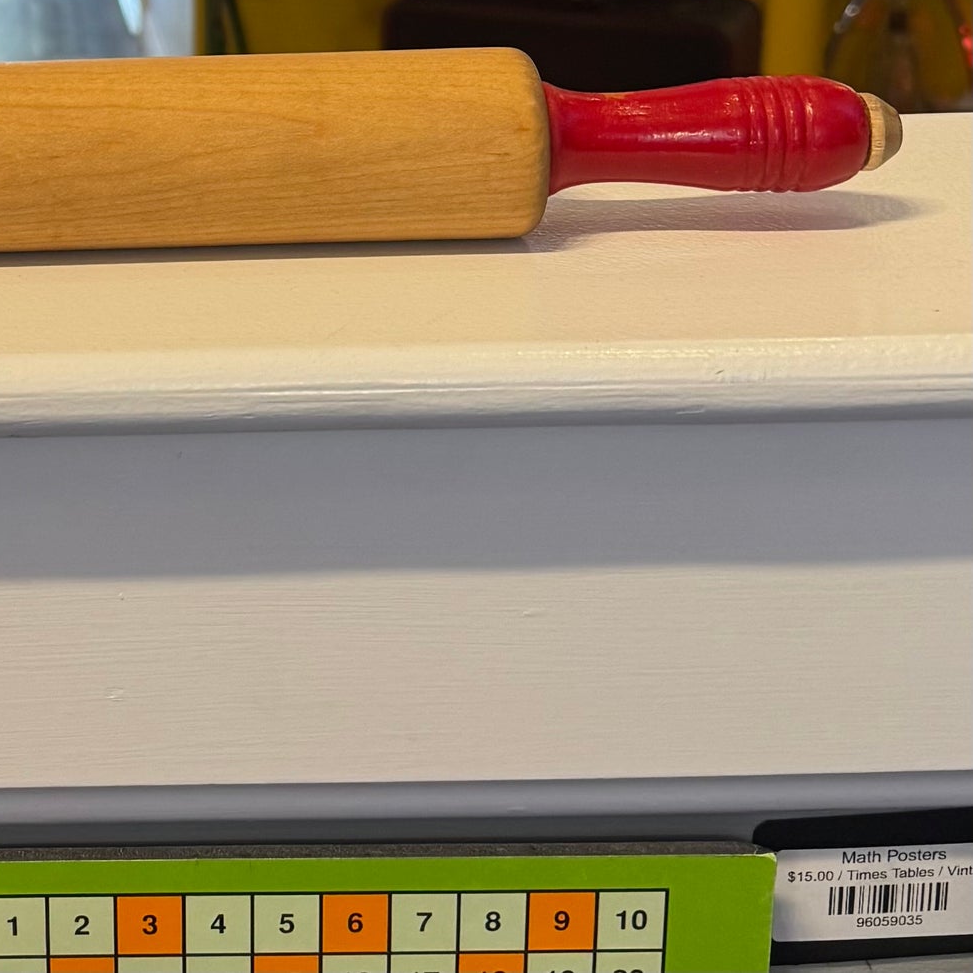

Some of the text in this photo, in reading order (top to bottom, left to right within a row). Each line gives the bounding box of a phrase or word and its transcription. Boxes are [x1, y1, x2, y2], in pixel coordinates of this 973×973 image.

[842, 849, 947, 864] Math Posters
[787, 865, 973, 883] $15.00 / Times Tables / Vint
[7, 910, 648, 936] 1 2 3 4 5 6 7 8 9 10
[856, 915, 923, 928] 96059035
